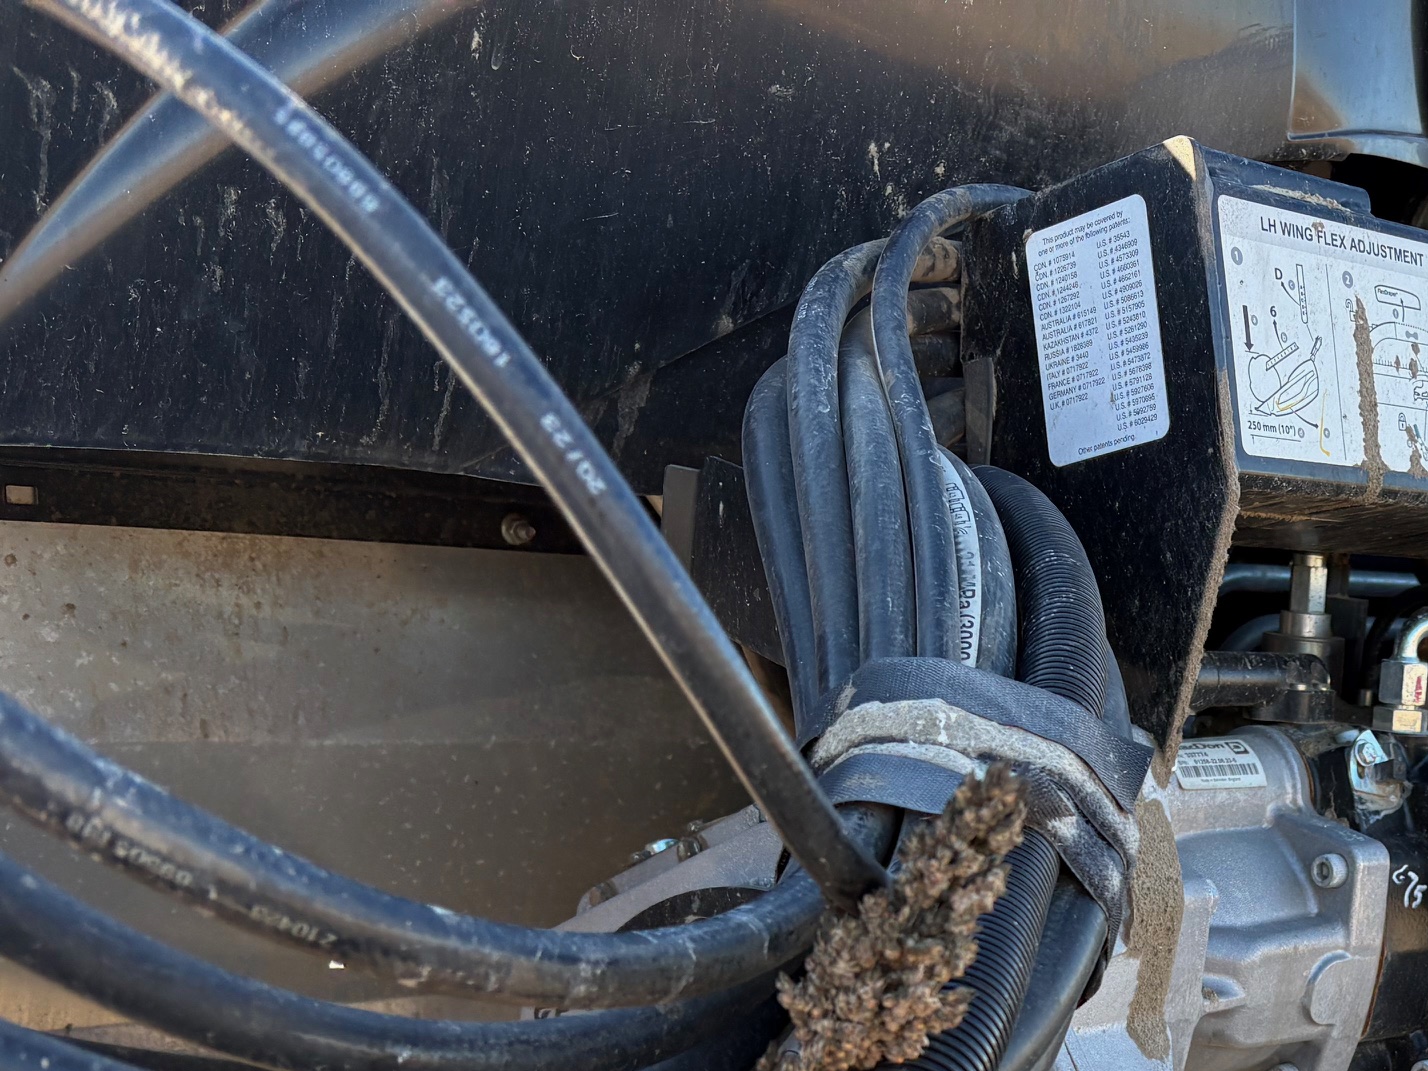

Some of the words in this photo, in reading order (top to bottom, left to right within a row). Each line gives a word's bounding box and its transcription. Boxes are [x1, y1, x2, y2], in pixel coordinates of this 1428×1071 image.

[1043, 235, 1053, 245] This
[1055, 229, 1073, 242] product
[1075, 225, 1085, 234] may
[1086, 221, 1093, 229] be
[1095, 213, 1115, 226] covered
[1116, 210, 1123, 219] by
[1038, 249, 1047, 257] one
[1056, 241, 1068, 250] more
[1075, 234, 1084, 242] the
[1085, 225, 1107, 240] following
[1097, 239, 1107, 249] U.S.
[1260, 216, 1278, 234] LH
[1281, 221, 1314, 242] WING
[1317, 230, 1347, 250] FLEX
[1350, 236, 1424, 268] ADJUSTMENT
[1098, 249, 1108, 259] U.S.
[1034, 261, 1047, 271] CDN.
[1099, 259, 1110, 269] U.S.
[1035, 271, 1048, 281] CDN.
[1274, 268, 1283, 280] D
[1036, 281, 1049, 291] CDN.
[1037, 291, 1050, 301] CDN.
[1102, 290, 1113, 300] U.S.
[1039, 301, 1052, 311] CDN.
[1040, 311, 1053, 321] CDN.
[1270, 306, 1277, 318] 6
[1041, 315, 1071, 331] AUSTRALIA
[1042, 325, 1072, 341] AUSTRALIA
[1043, 333, 1079, 351] KAZAKHSTAN
[1046, 357, 1070, 371] UKRAINE
[1110, 361, 1121, 371] U.S.
[1047, 370, 1061, 381] ITALY
[1048, 378, 1070, 391] FRANCE
[1113, 382, 1123, 391] U.S.
[1049, 386, 1076, 401] GERMANY
[1114, 392, 1125, 401] U.S.
[1050, 402, 1061, 411] U.K.
[1247, 421, 1260, 432] 250
[1262, 424, 1277, 434] mm
[1078, 446, 1093, 455] Other
[1094, 441, 1112, 452] patents
